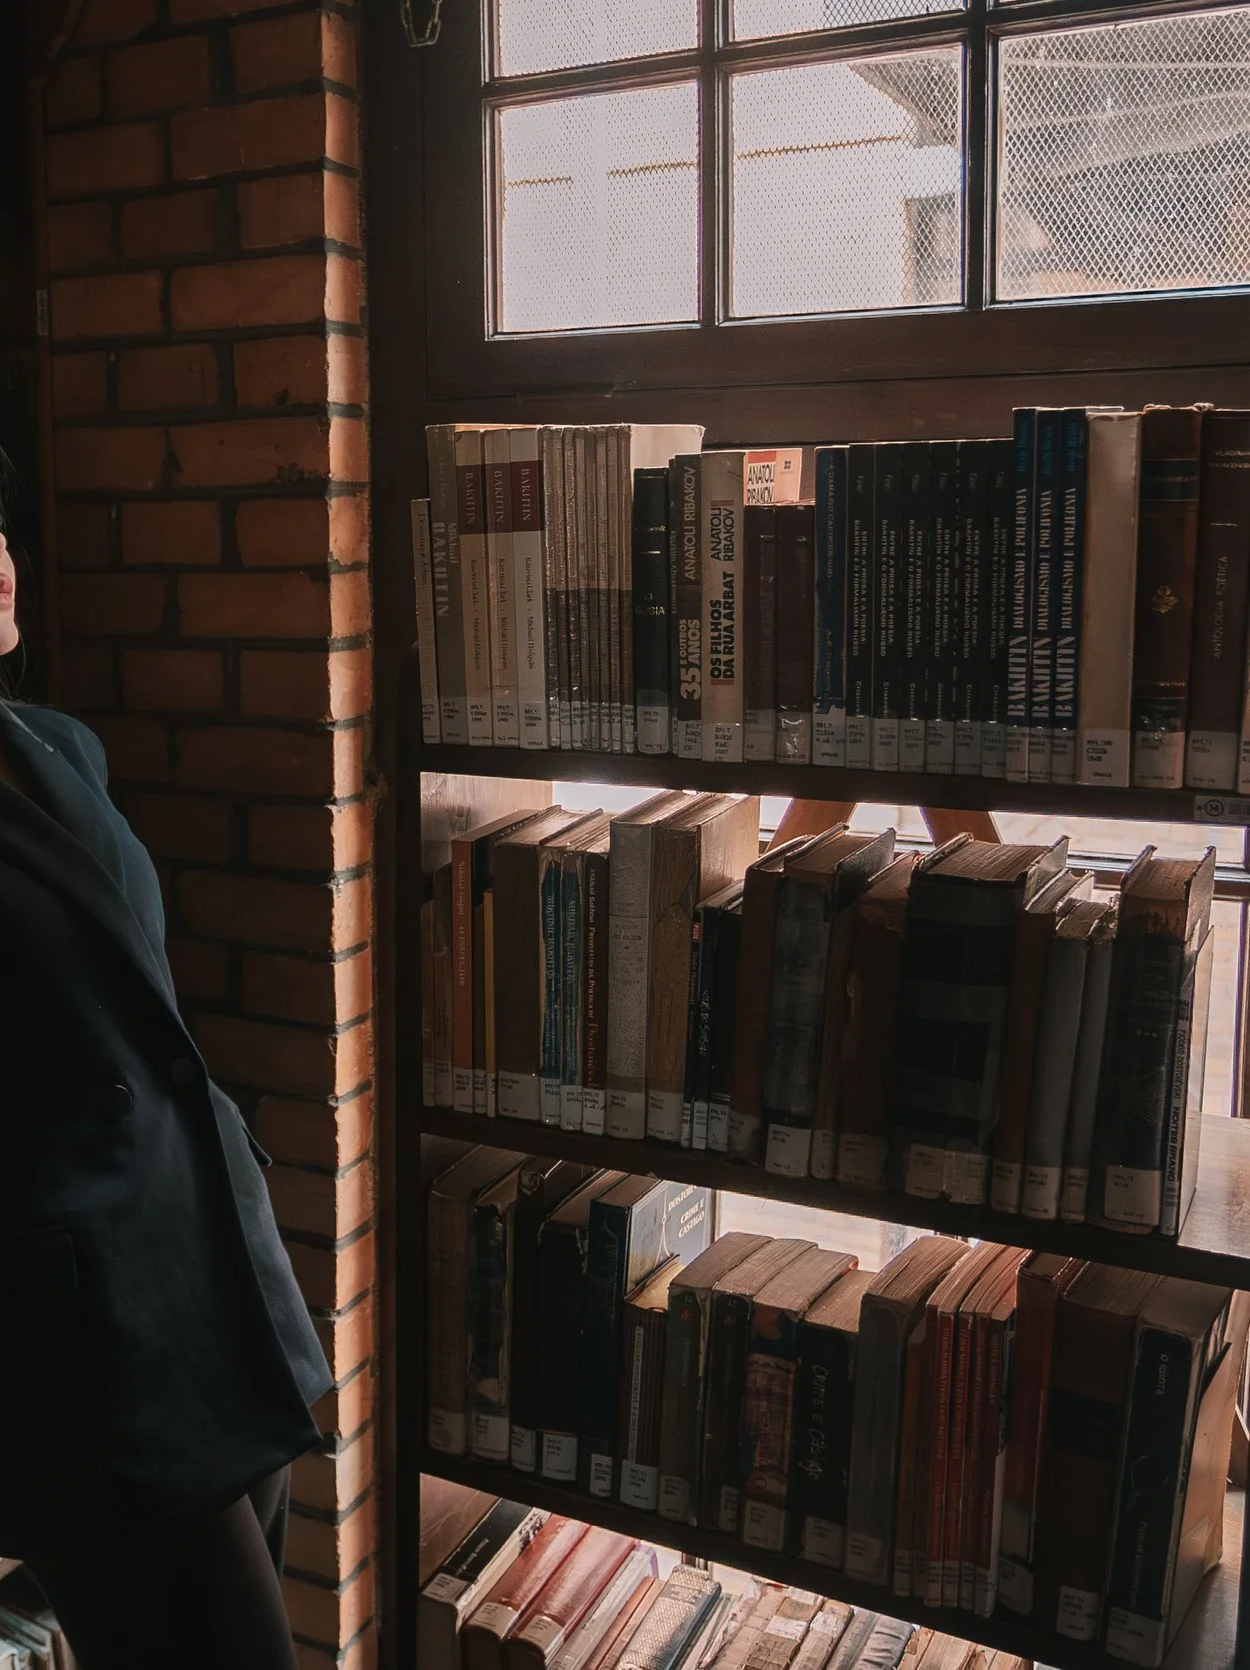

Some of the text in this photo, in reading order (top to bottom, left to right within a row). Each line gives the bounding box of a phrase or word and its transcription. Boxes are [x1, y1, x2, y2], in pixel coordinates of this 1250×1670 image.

[465, 471, 477, 525] BAKHTIN
[493, 470, 504, 523] BAKHTIN
[520, 468, 532, 522] BAKHTIN
[746, 463, 776, 486] ANATOLI
[683, 465, 696, 580] ANATOLI RIBAKOV
[710, 506, 721, 561] ANATOLI
[722, 507, 734, 561] RIBAKOV
[431, 521, 450, 617] BAKHTIN
[722, 571, 734, 679] DA RUA ARBAT
[1007, 488, 1027, 716] BAKHTIN DIALOGISMO E POLIFONIA
[1031, 489, 1052, 717] BAKHTIN DIALOGISMO E POLIFONIA
[1054, 487, 1076, 716] BAKHTIN DIALOGISMO E POLIFONIA
[679, 618, 688, 658] OUTROS
[687, 618, 701, 665] ANOS
[710, 599, 722, 679] OS FILHOS
[679, 667, 701, 700] 35
[678, 1210, 705, 1238] CASTIGO
